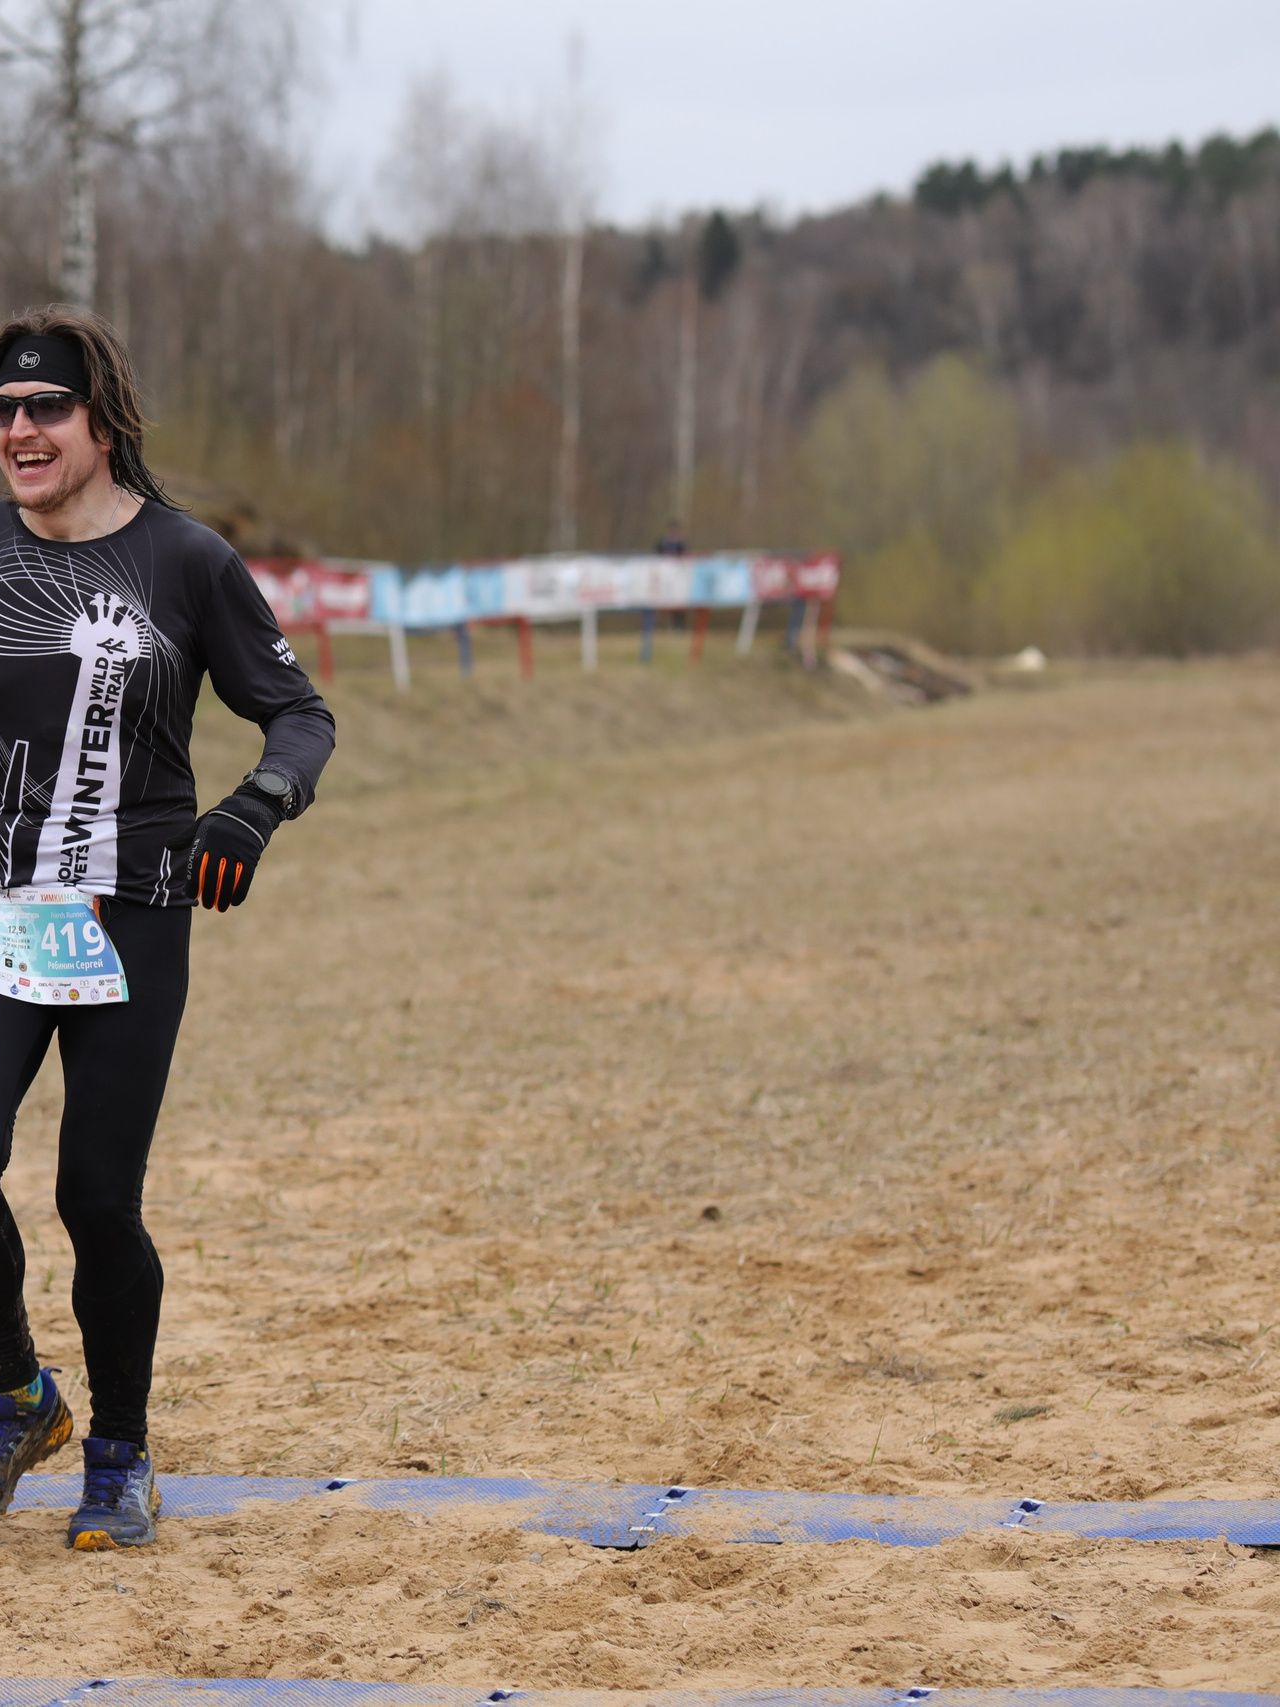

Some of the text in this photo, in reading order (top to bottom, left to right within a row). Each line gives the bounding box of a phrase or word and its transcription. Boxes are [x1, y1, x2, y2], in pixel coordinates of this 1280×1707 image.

[89, 656, 109, 701] WILD
[104, 657, 127, 704] TRAIL
[62, 703, 116, 845] WINTER
[58, 847, 74, 882] OLA
[41, 920, 106, 957] 419
[47, 958, 104, 972] Рябинин Сергей
